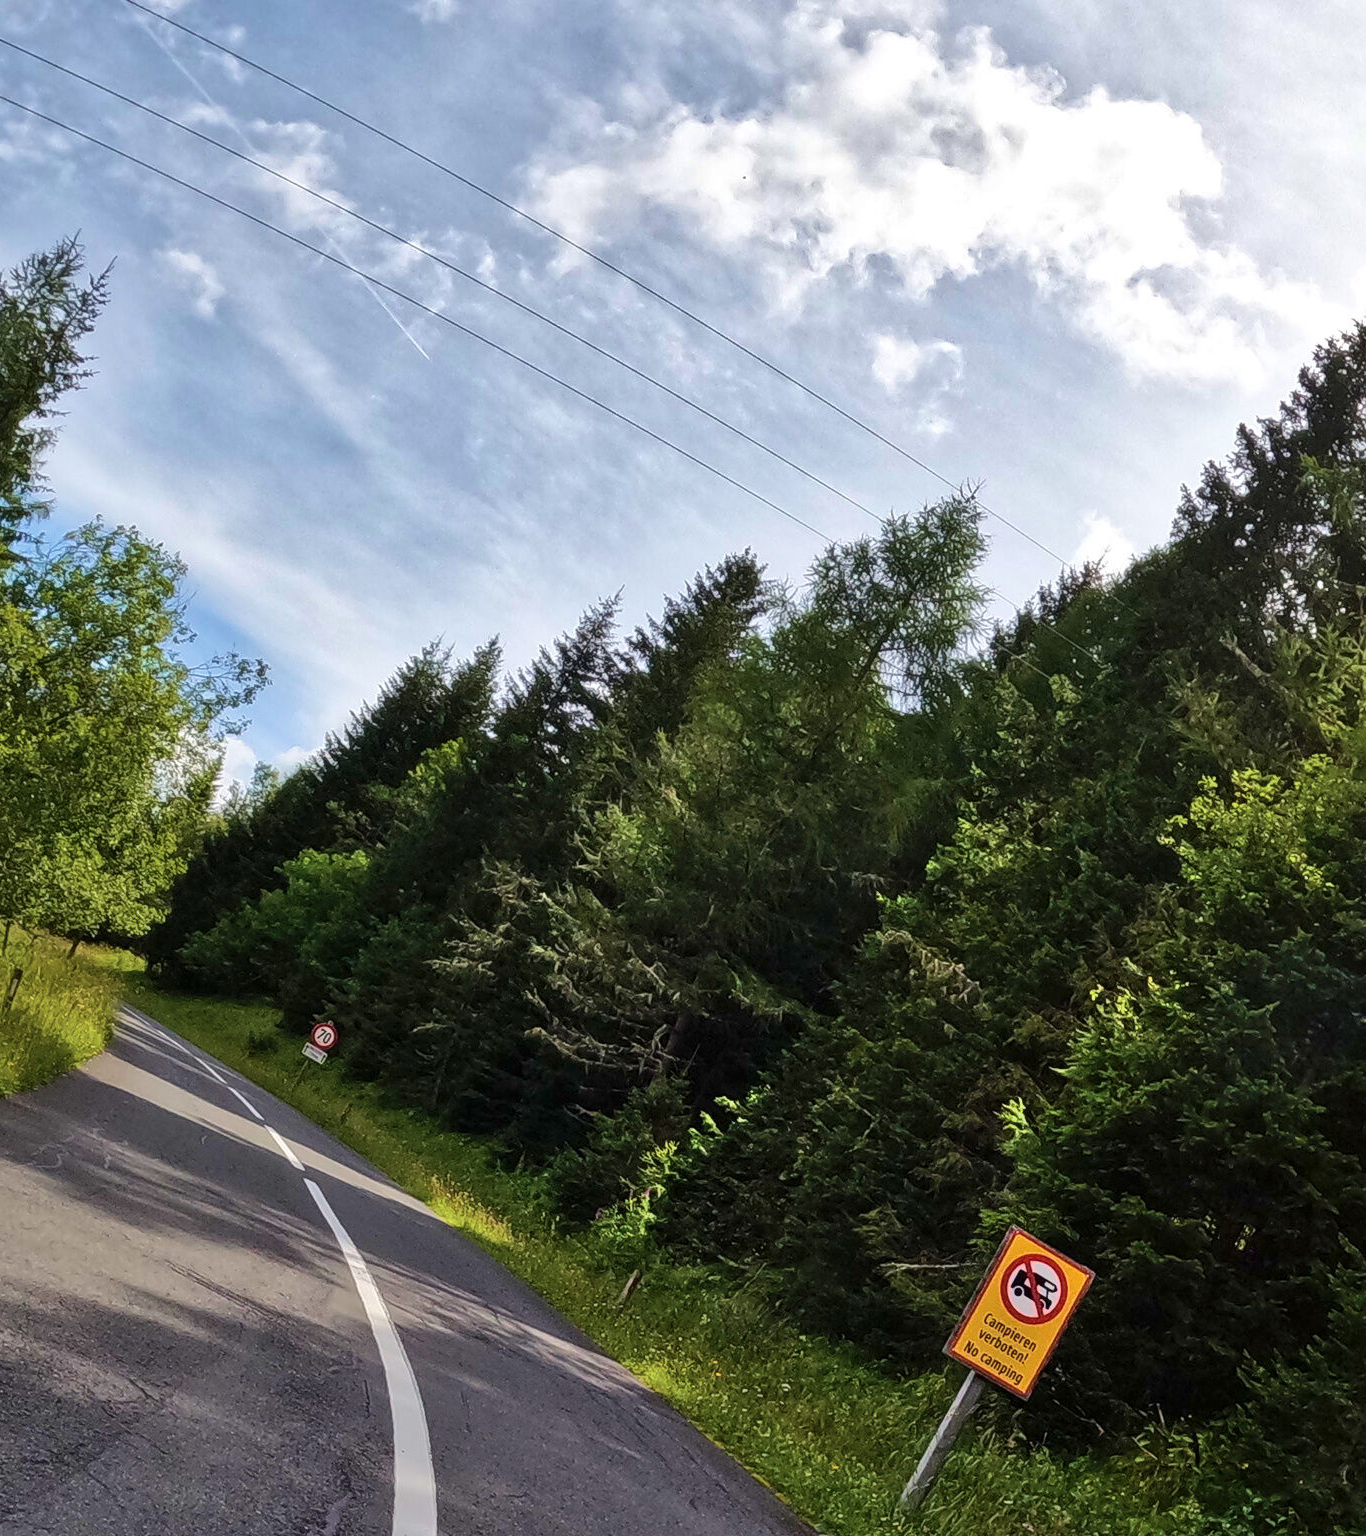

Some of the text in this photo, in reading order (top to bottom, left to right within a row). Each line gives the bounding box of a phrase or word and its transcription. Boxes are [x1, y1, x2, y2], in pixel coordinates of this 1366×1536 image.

[317, 1028, 332, 1044] 70
[979, 1329, 1029, 1364] verboten!
[983, 1313, 1037, 1352] Campieren
[963, 1341, 1024, 1386] No camping
